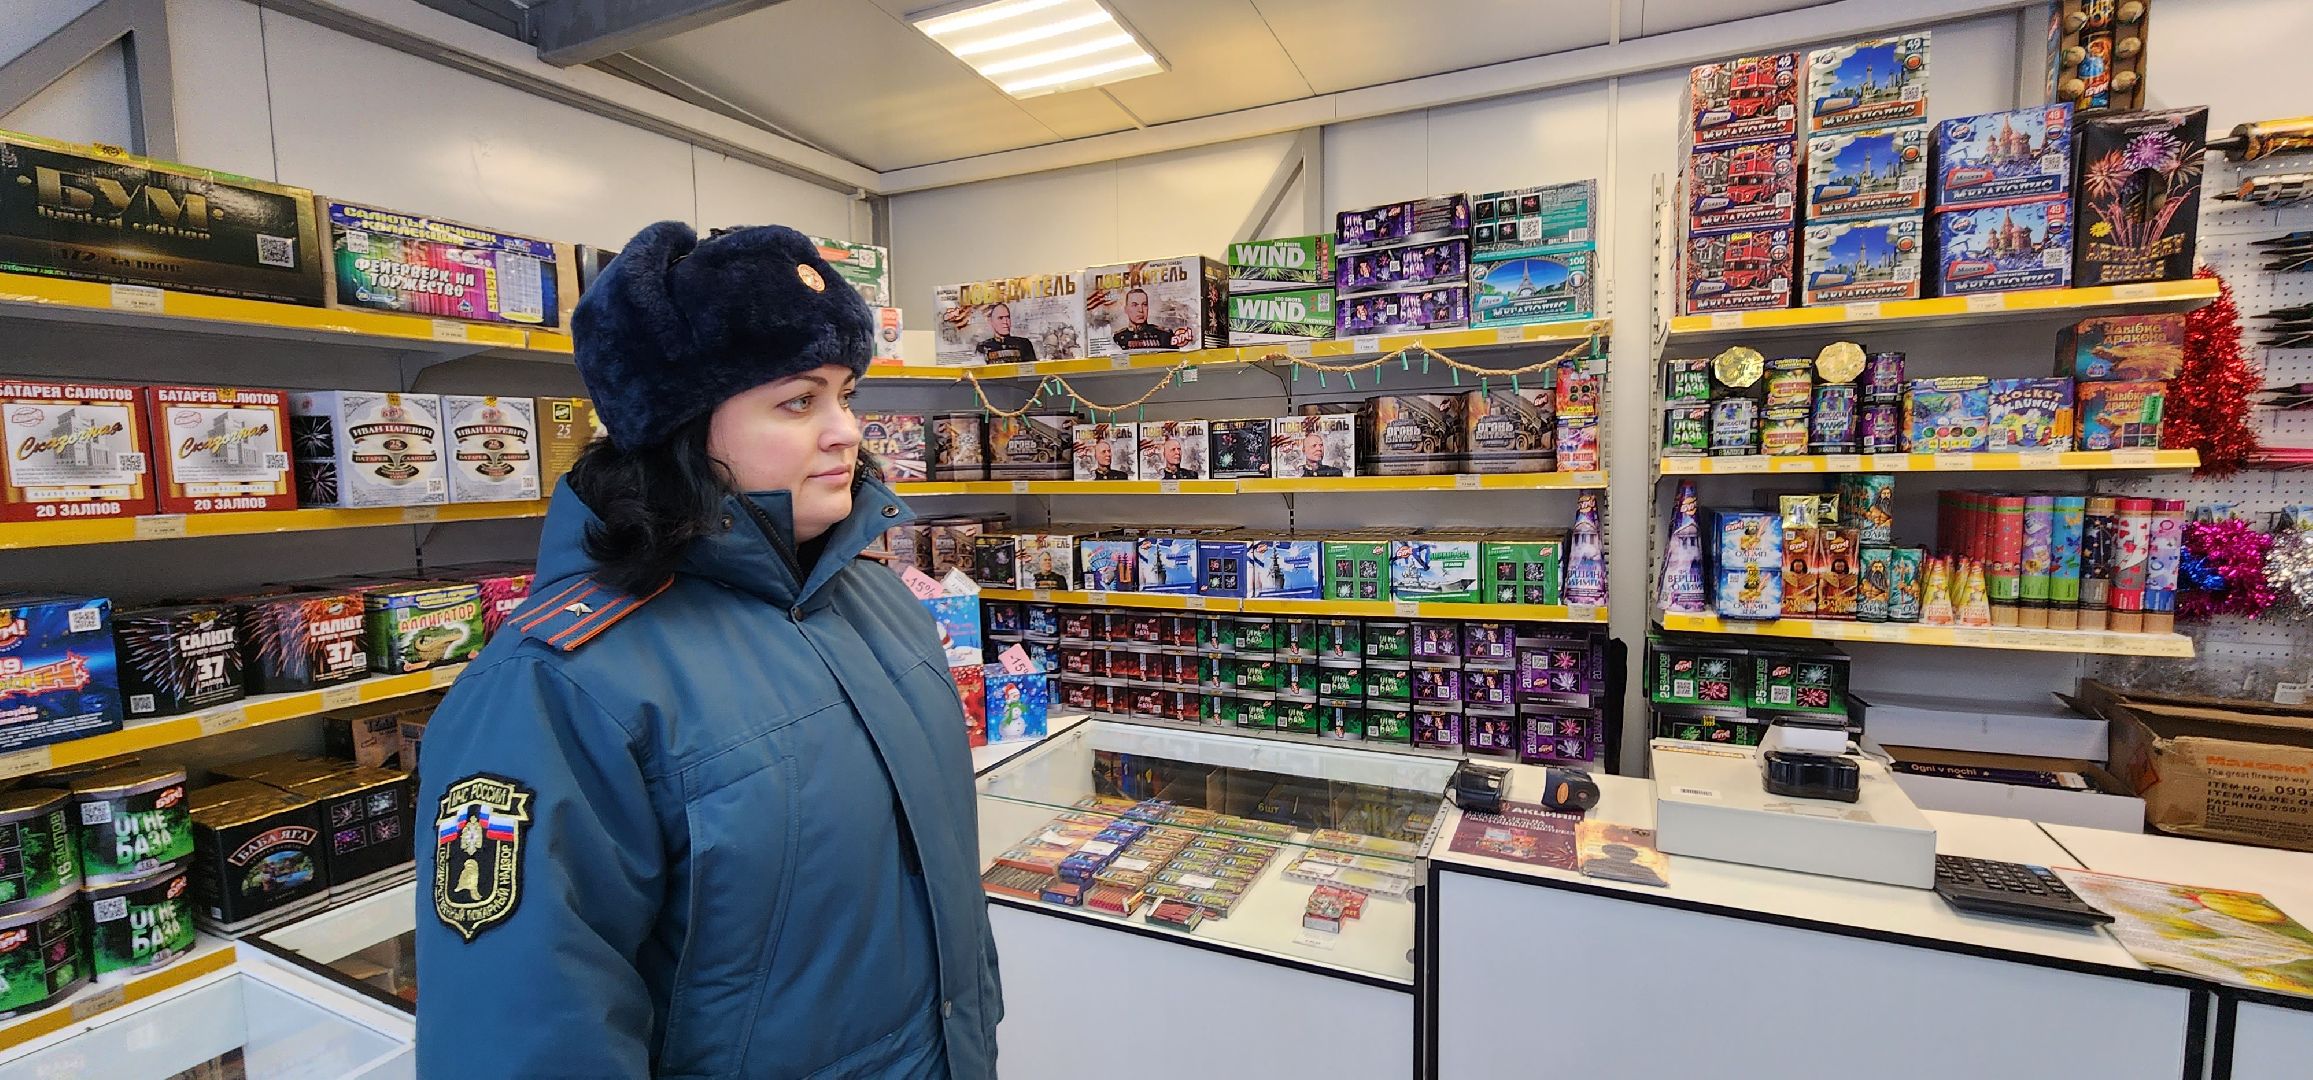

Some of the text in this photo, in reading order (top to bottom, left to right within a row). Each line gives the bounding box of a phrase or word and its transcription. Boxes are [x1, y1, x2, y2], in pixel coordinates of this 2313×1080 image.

[1907, 38, 1922, 50] 49
[1778, 56, 1791, 67] 49
[1904, 131, 1919, 141] 49
[1777, 145, 1790, 155] 49
[36, 166, 208, 230] БУМ
[1899, 222, 1912, 232] 49
[1772, 231, 1786, 241] 49
[1236, 245, 1305, 269] WIND
[1569, 257, 1585, 266] 100
[354, 258, 475, 287] ФЕЙЕРВЕРК НА
[1095, 266, 1187, 290] ПОБЕДИТЕЛЬ
[370, 273, 464, 297] ТОРЖЕСТВО
[960, 274, 1076, 304] ПОБЕДИТЕЛЬ
[1237, 299, 1305, 322] WIND
[1171, 327, 1192, 347] БУМ!
[65, 387, 133, 401] САЛЮТОВ
[158, 389, 216, 402] БАТАРЕЯ
[2000, 389, 2063, 403] ROCKET
[2009, 399, 2058, 411] LAUNCH
[352, 425, 433, 438] ИВАН ЦАРЕВИЧ
[457, 425, 527, 439] ИВАН ЦАРЕВИЧ
[556, 424, 571, 437] 25
[1387, 426, 1421, 437] ОГОНЬ
[1478, 422, 1513, 433] ОГОНЬ
[15, 422, 123, 460] Сказочная
[178, 423, 269, 459] Сказочная
[35, 502, 121, 517] 20 ЗАЛПОВ
[194, 498, 266, 511] 20 ЗАЛПОВ
[401, 604, 474, 633] АЛЛИГАТОР
[310, 615, 364, 637] САЛЮТ
[180, 628, 235, 651] САЛЮТ
[326, 641, 353, 664] 37
[197, 655, 225, 681] 37
[1660, 684, 1670, 698] 25
[1756, 690, 1767, 704] 25
[1911, 763, 1936, 773] Ogni
[1947, 767, 1977, 776] nochi
[2207, 768, 2224, 776] The
[2226, 770, 2249, 779] great
[2251, 772, 2289, 781] firework
[2207, 781, 2239, 791] ITEM
[451, 783, 508, 807] МЧС РОССИИ
[2207, 790, 2243, 799] ITEM
[1258, 802, 1280, 813] 6шт
[2207, 804, 2226, 814] RU
[114, 810, 168, 838] ОГНЕ
[115, 829, 173, 865] БАЗА
[238, 829, 309, 861] БАБА ЯГА
[130, 901, 177, 930] ОГНЕ
[131, 920, 181, 958] БАЗА
